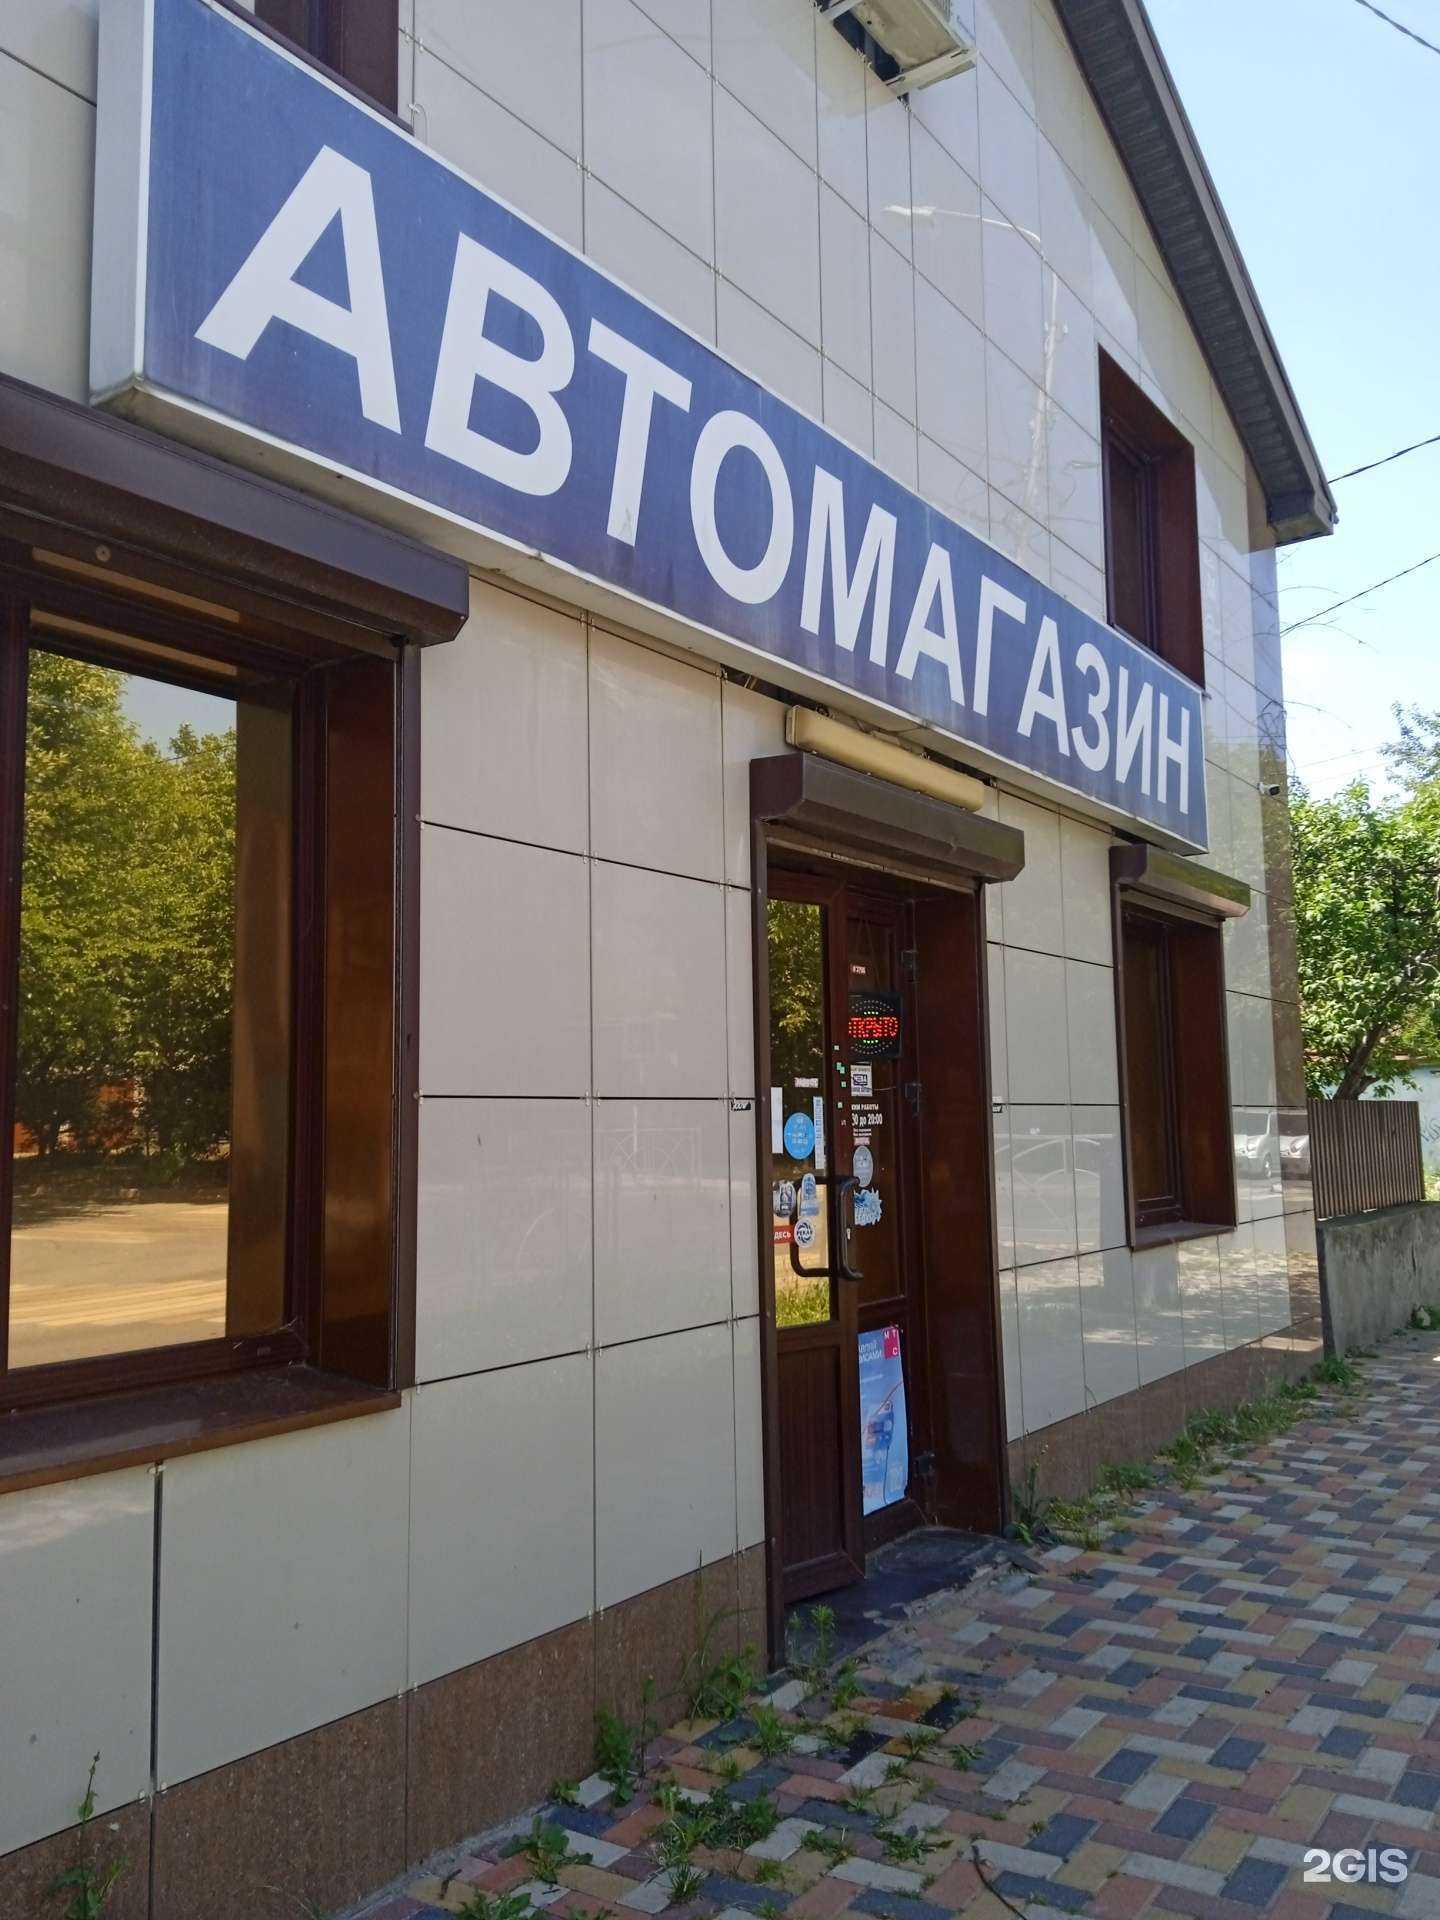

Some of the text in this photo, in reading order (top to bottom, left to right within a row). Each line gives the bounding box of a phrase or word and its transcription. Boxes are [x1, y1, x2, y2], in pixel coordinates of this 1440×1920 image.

[194, 145, 1190, 815] АВТОМАГАЗИН
[859, 1116, 867, 1127] до
[867, 1113, 883, 1125] 20:00
[774, 1231, 792, 1240] ДЕСЬ
